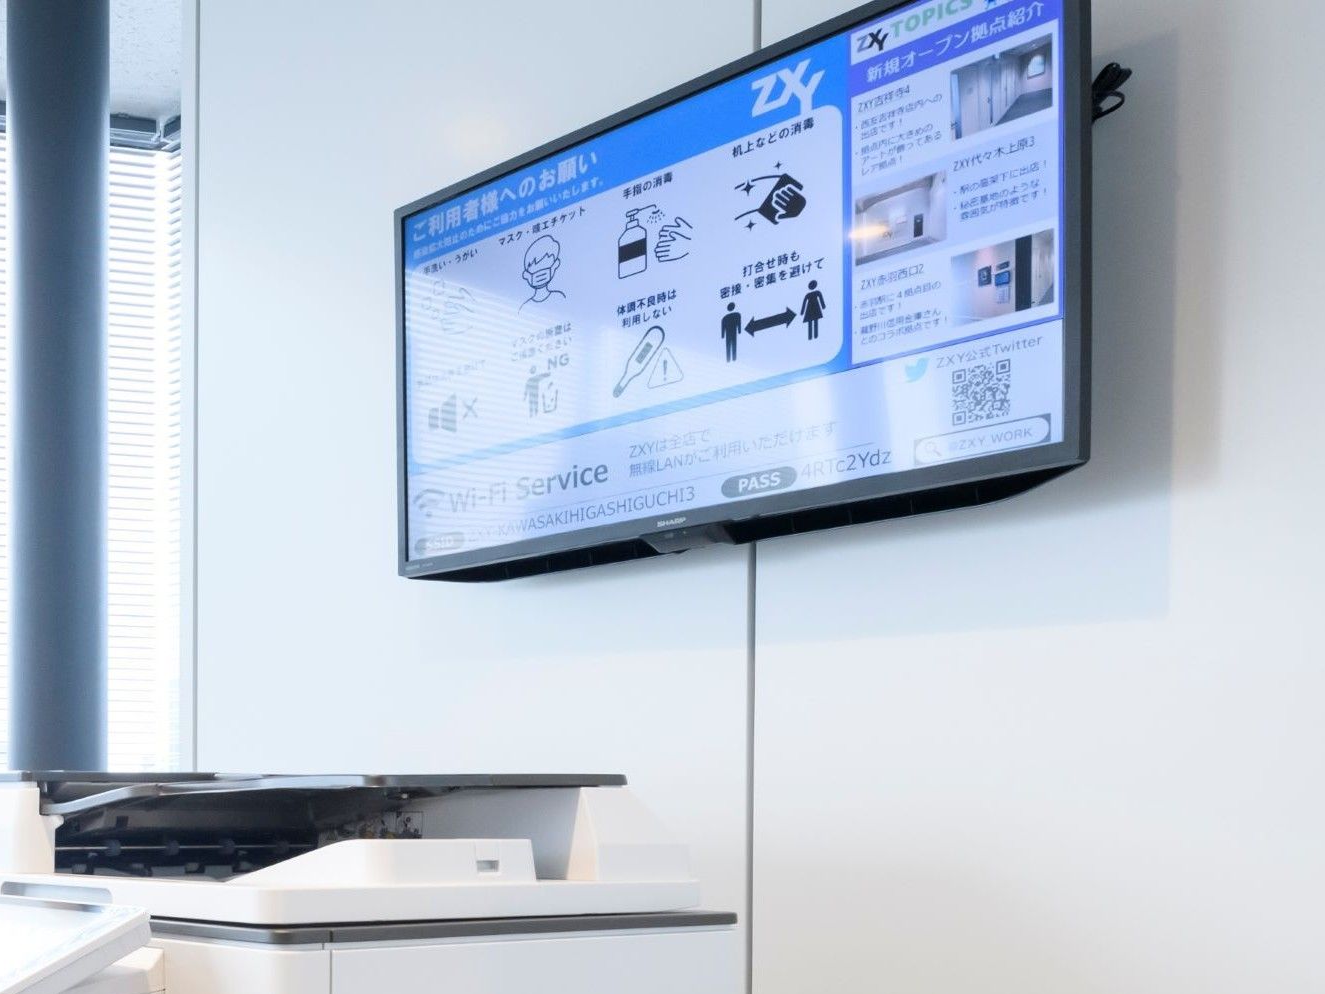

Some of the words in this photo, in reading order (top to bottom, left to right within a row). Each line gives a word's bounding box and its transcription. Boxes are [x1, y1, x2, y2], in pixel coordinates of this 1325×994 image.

[857, 28, 889, 52] ZXY
[890, 0, 972, 38] TOPICS
[866, 1, 1045, 83] 新規オープン拠点紹介
[751, 58, 825, 118] ZXY
[732, 117, 815, 158] 机上などの消毒
[953, 135, 1035, 172] ZXY代々木上原3
[412, 151, 598, 242] ご利用者様へのお願い
[622, 171, 674, 200] 手指の消毒
[498, 205, 587, 247] マスク・咳エチケット
[719, 257, 826, 300] 密接・密集を避けて
[742, 250, 800, 278] 打合せ時も
[860, 263, 924, 290] ZXY赤羽西口2
[616, 289, 677, 317] 体調不良時は
[621, 305, 672, 329] 利用しない
[547, 353, 570, 371] NG
[936, 336, 1043, 369] ZXY公式Twitter
[629, 428, 710, 459] ZXYは全店で
[629, 421, 837, 478] 無線LANがご利用いただけます
[990, 428, 1033, 444] WORK
[449, 481, 507, 513] Wi-Fi
[516, 463, 609, 500] Service
[738, 471, 781, 493] PASS
[800, 449, 893, 480] 4RTc2Ydz
[657, 516, 687, 528] SHARP
